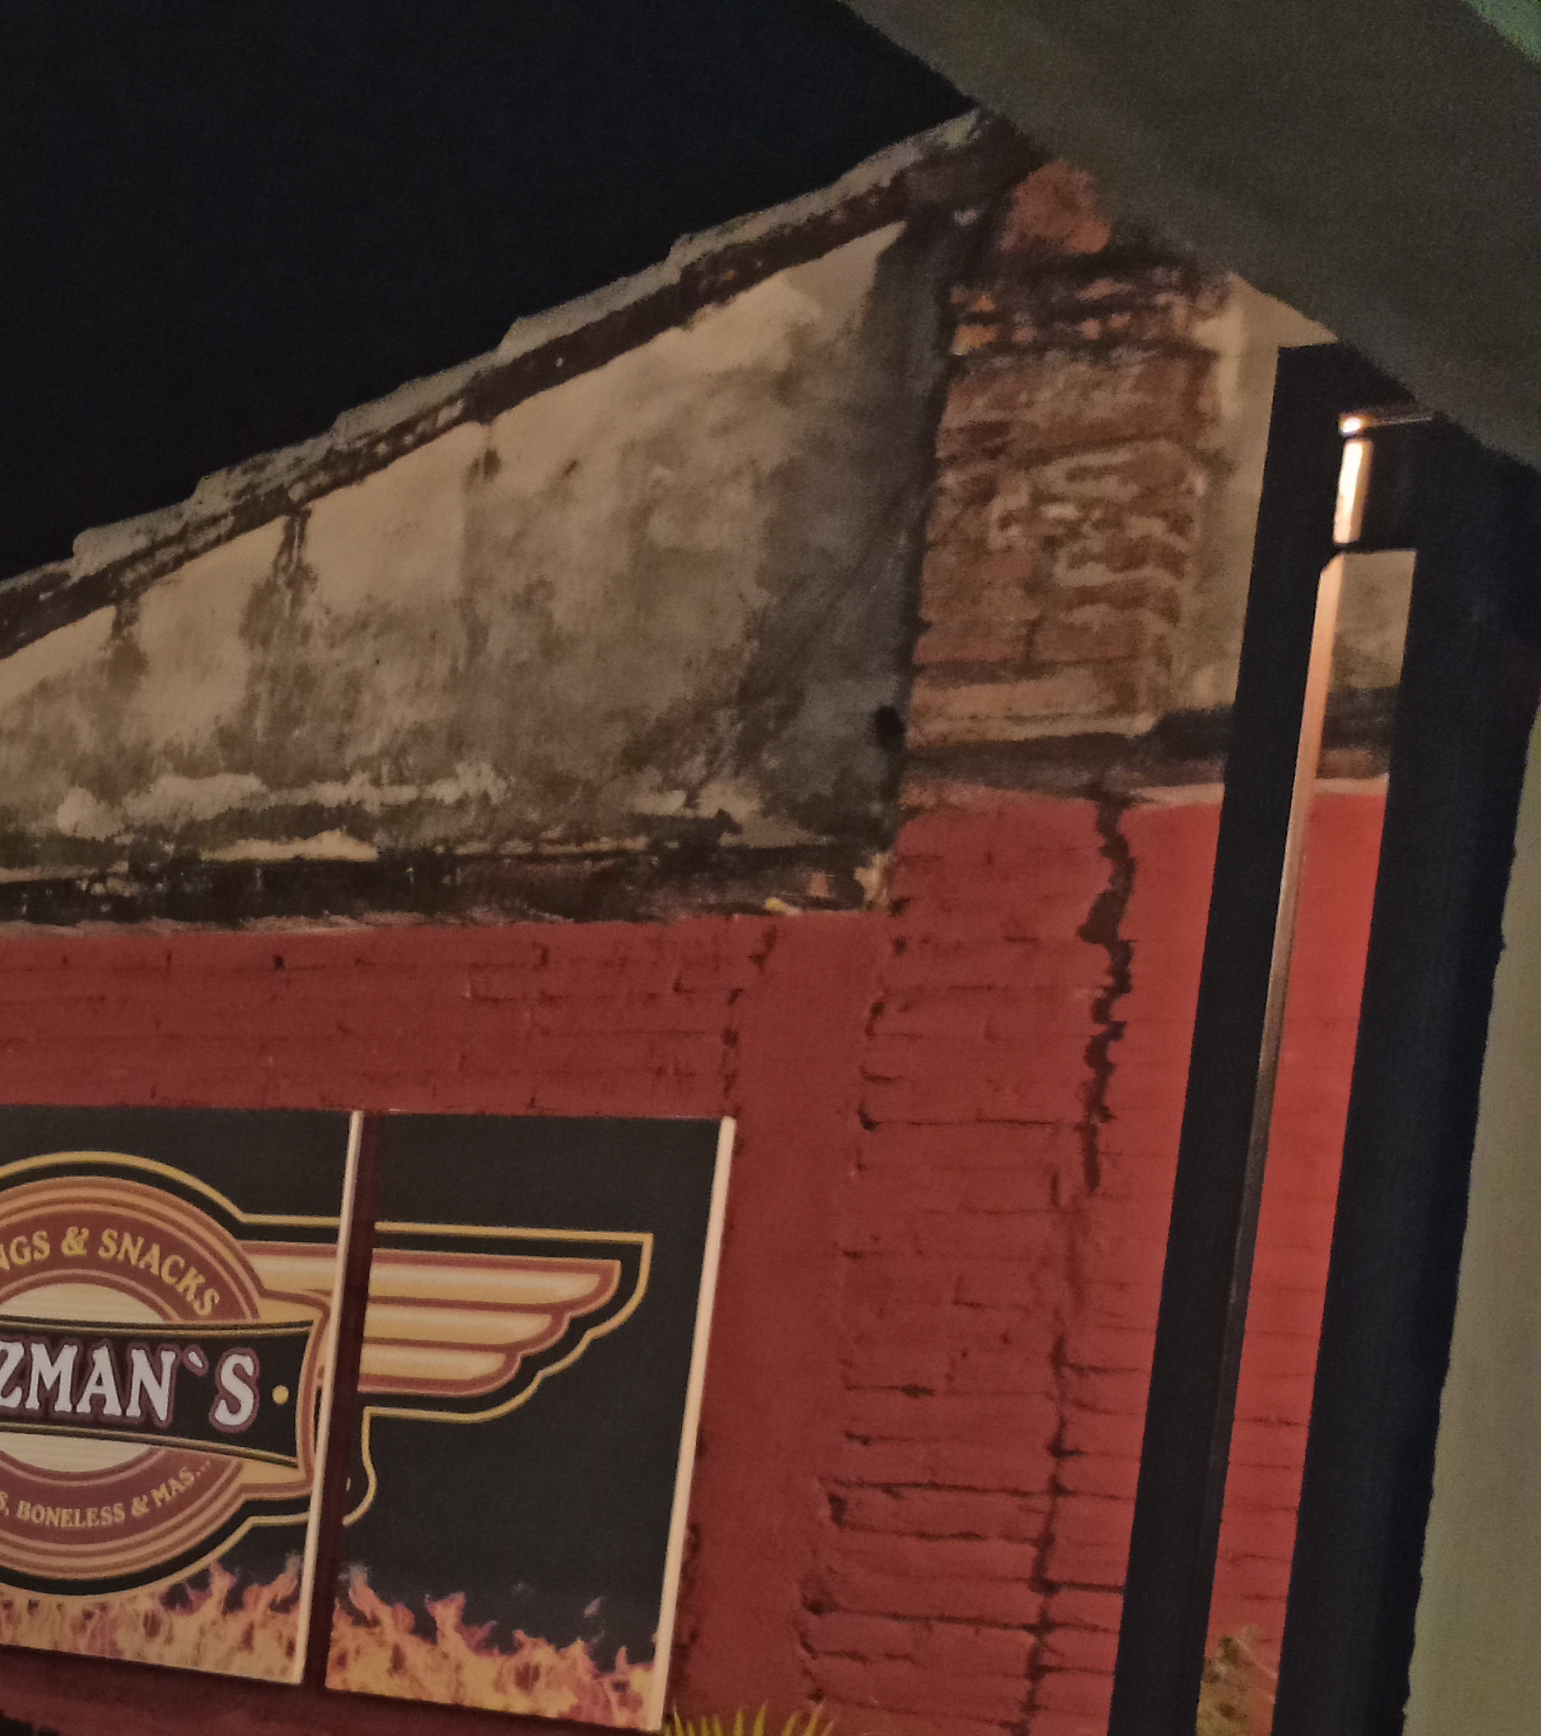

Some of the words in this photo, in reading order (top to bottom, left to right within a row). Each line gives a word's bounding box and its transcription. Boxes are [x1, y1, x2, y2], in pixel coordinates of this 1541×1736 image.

[61, 1226, 90, 1257] &
[98, 1228, 220, 1316] SNACKS
[17, 1500, 126, 1528] BONELESS
[131, 1495, 150, 1518] &
